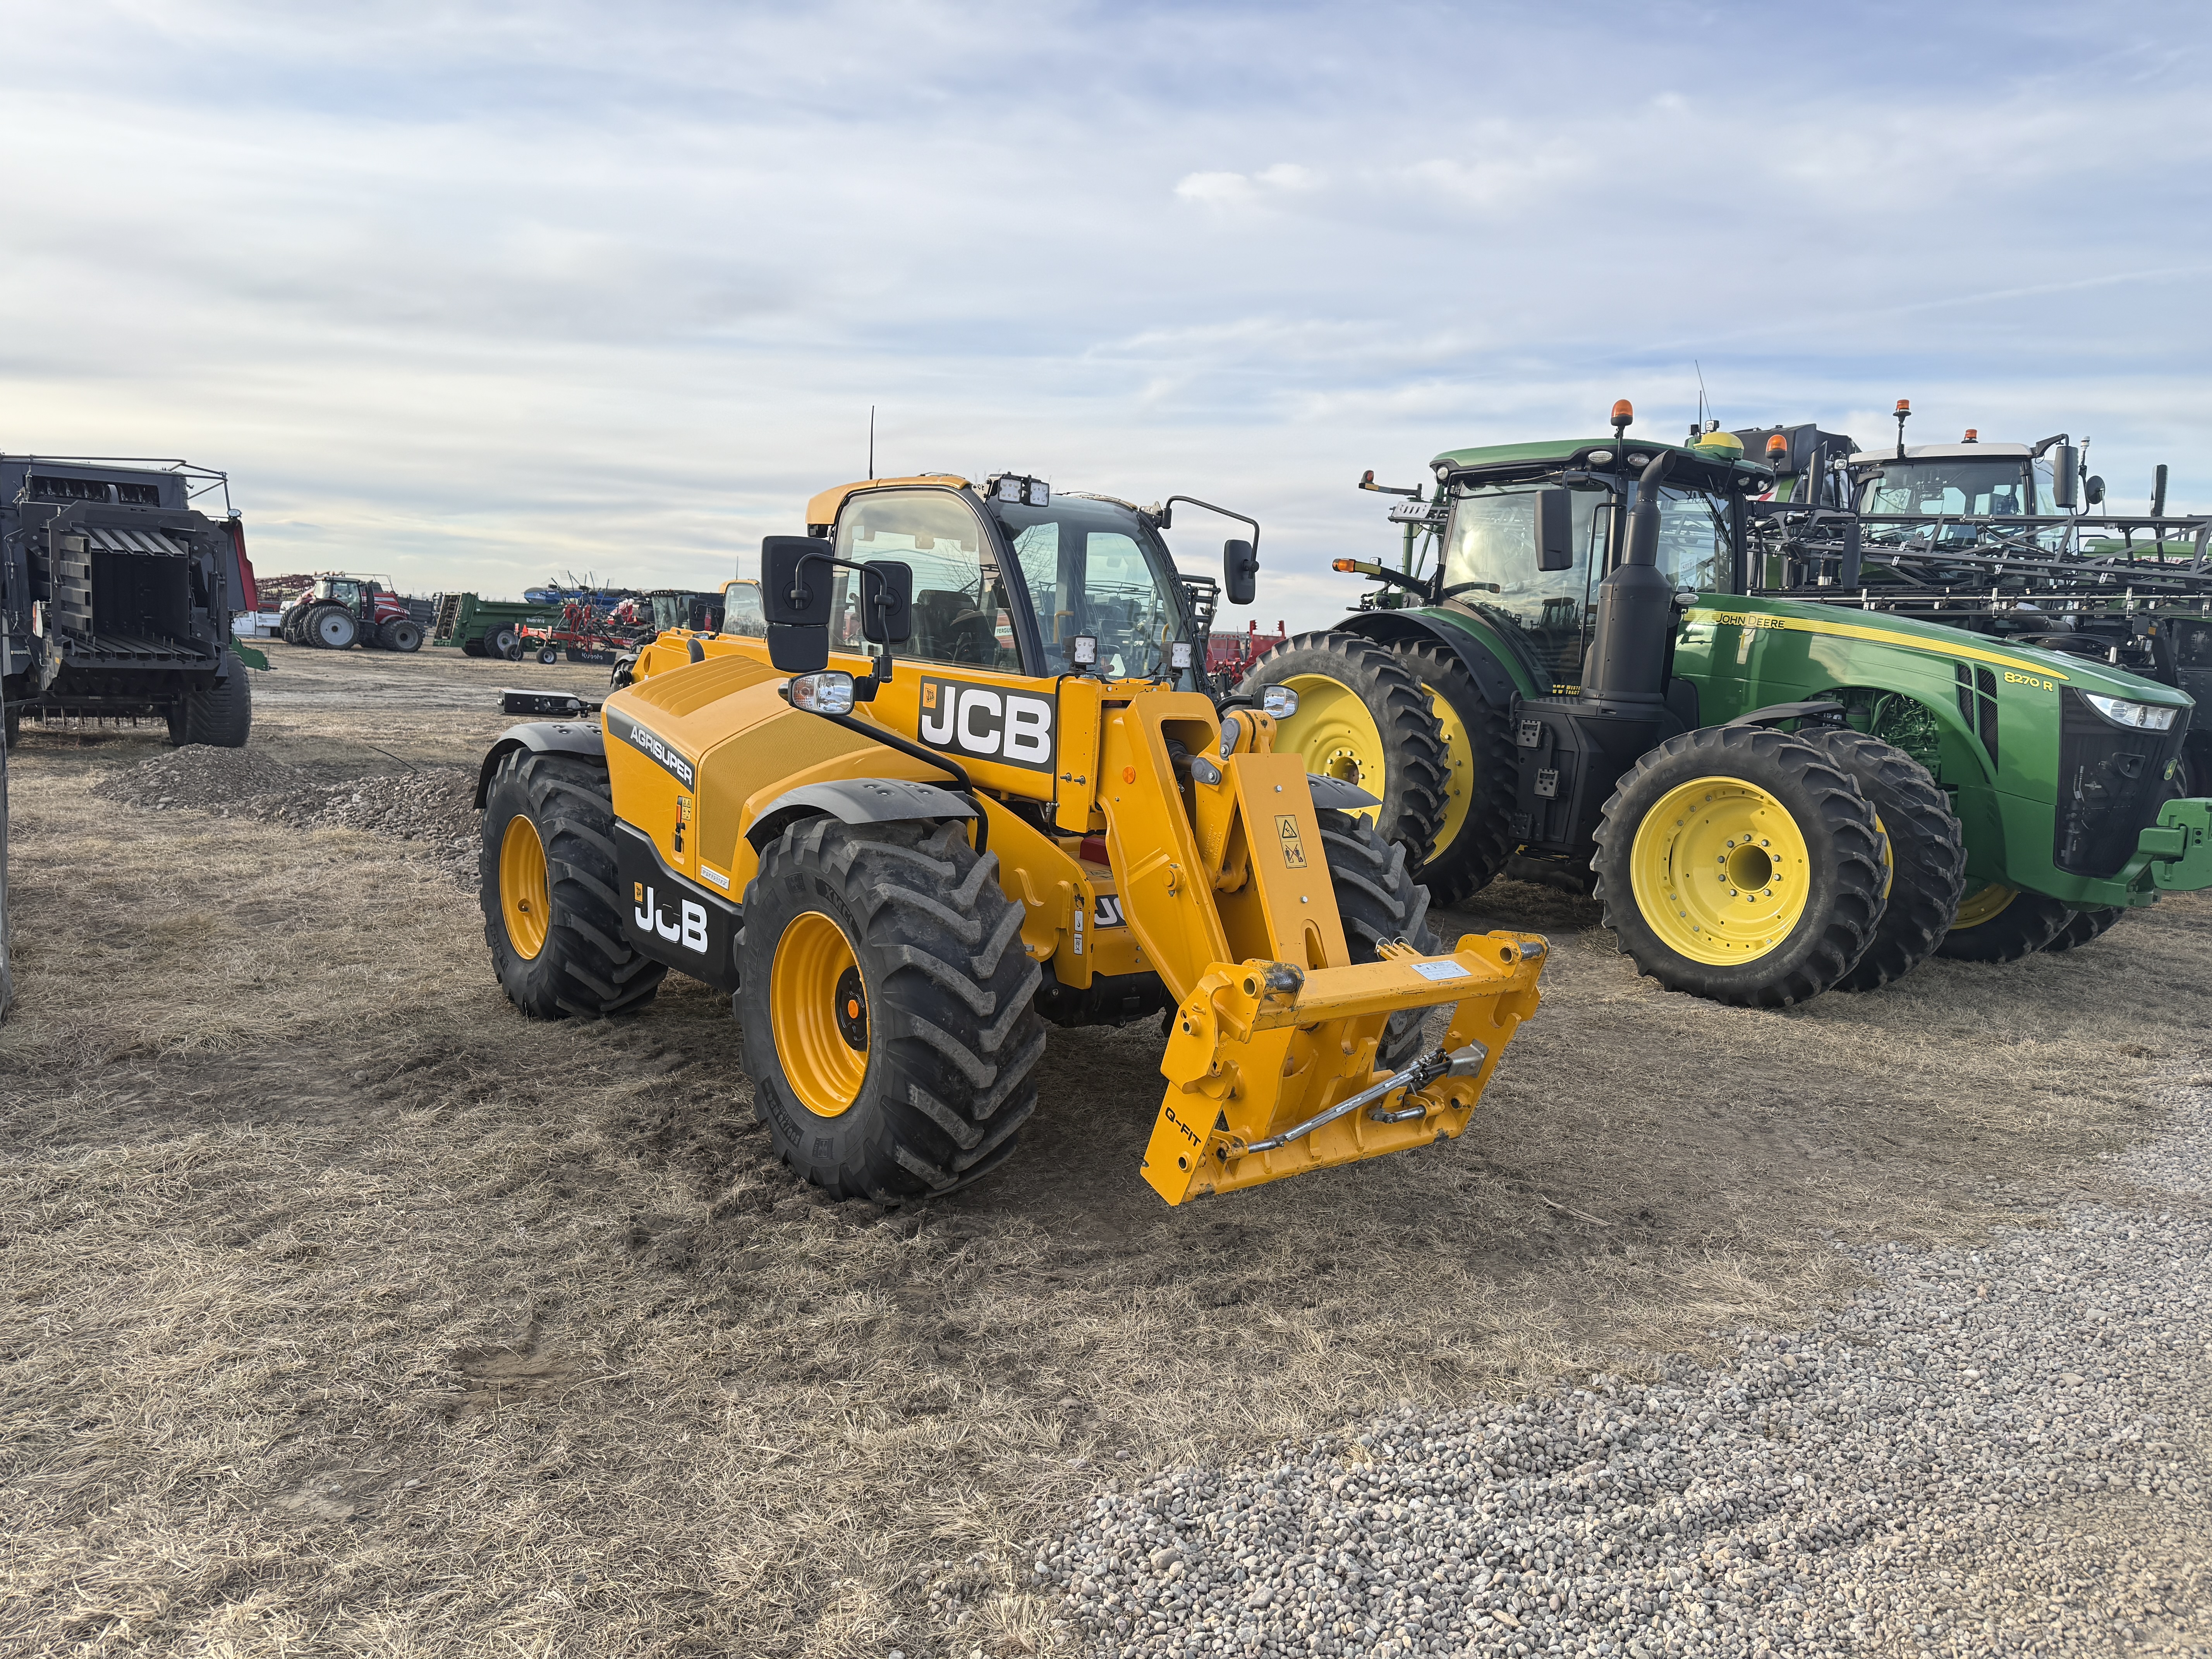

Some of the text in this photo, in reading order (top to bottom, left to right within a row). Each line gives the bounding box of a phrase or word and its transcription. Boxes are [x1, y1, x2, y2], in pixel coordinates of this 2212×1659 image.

[1716, 613, 1785, 628] JOHN DEERE
[2004, 672, 2053, 692] 8270 R
[922, 686, 1051, 763] JCB
[630, 725, 692, 785] AGRISUPER
[635, 886, 708, 953] JCB
[1165, 1107, 1201, 1147] Q-FIT
